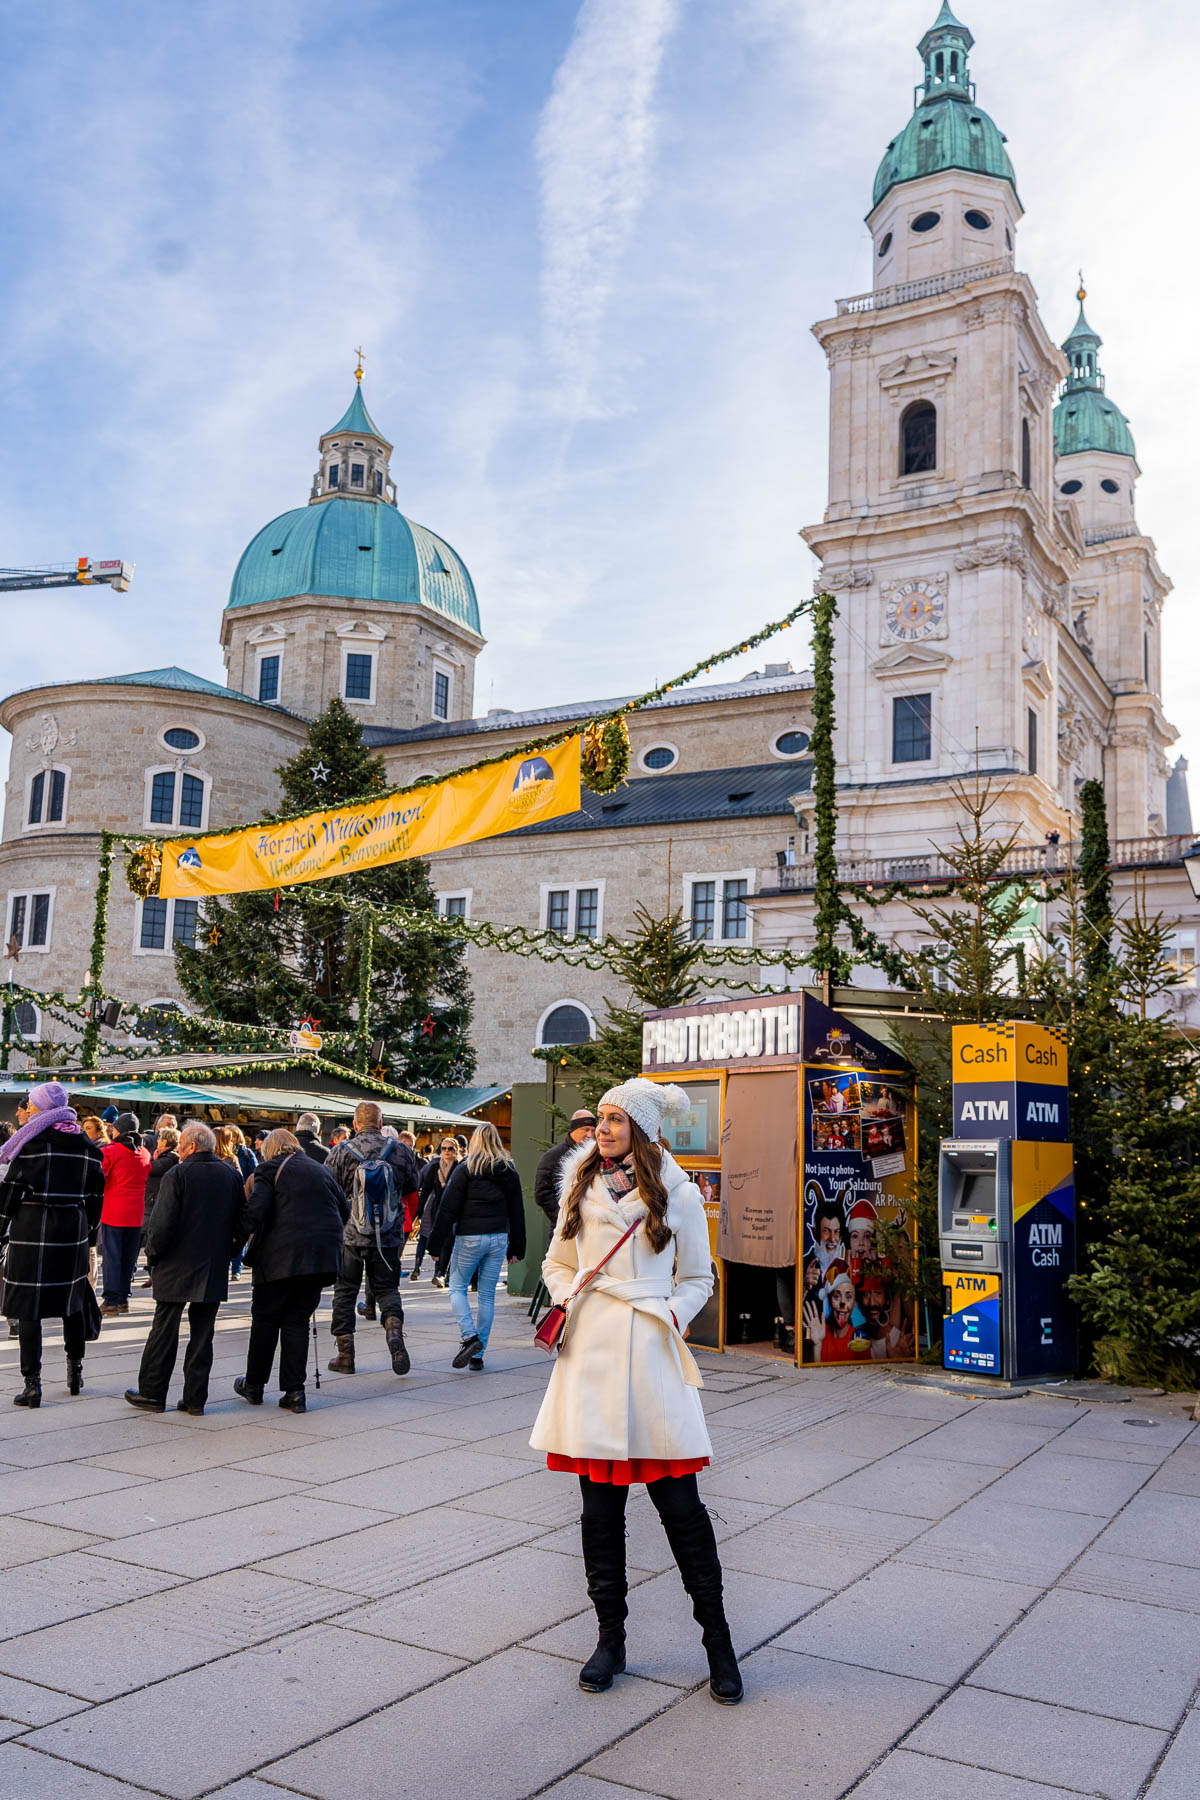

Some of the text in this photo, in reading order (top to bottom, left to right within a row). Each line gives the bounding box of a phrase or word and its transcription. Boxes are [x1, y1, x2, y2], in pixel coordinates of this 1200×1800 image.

[255, 798, 430, 859] Herzlich Willkommen!
[269, 851, 326, 880] Welcome!
[339, 829, 411, 866] Benvenuti!
[642, 1004, 799, 1065] PHOTOBOOTH
[960, 1042, 1007, 1063] Cash
[1025, 1043, 1058, 1066] Cash
[960, 1100, 1009, 1121] ATM
[1026, 1101, 1059, 1123] ATM
[805, 1163, 817, 1174] Not
[817, 1165, 830, 1176] just
[836, 1165, 855, 1176] photo
[828, 1177, 882, 1193] Your Salzburg
[875, 1194, 886, 1206] AR
[1028, 1223, 1062, 1245] ATM
[1032, 1248, 1060, 1267] Cash
[955, 1277, 986, 1291] ATM
